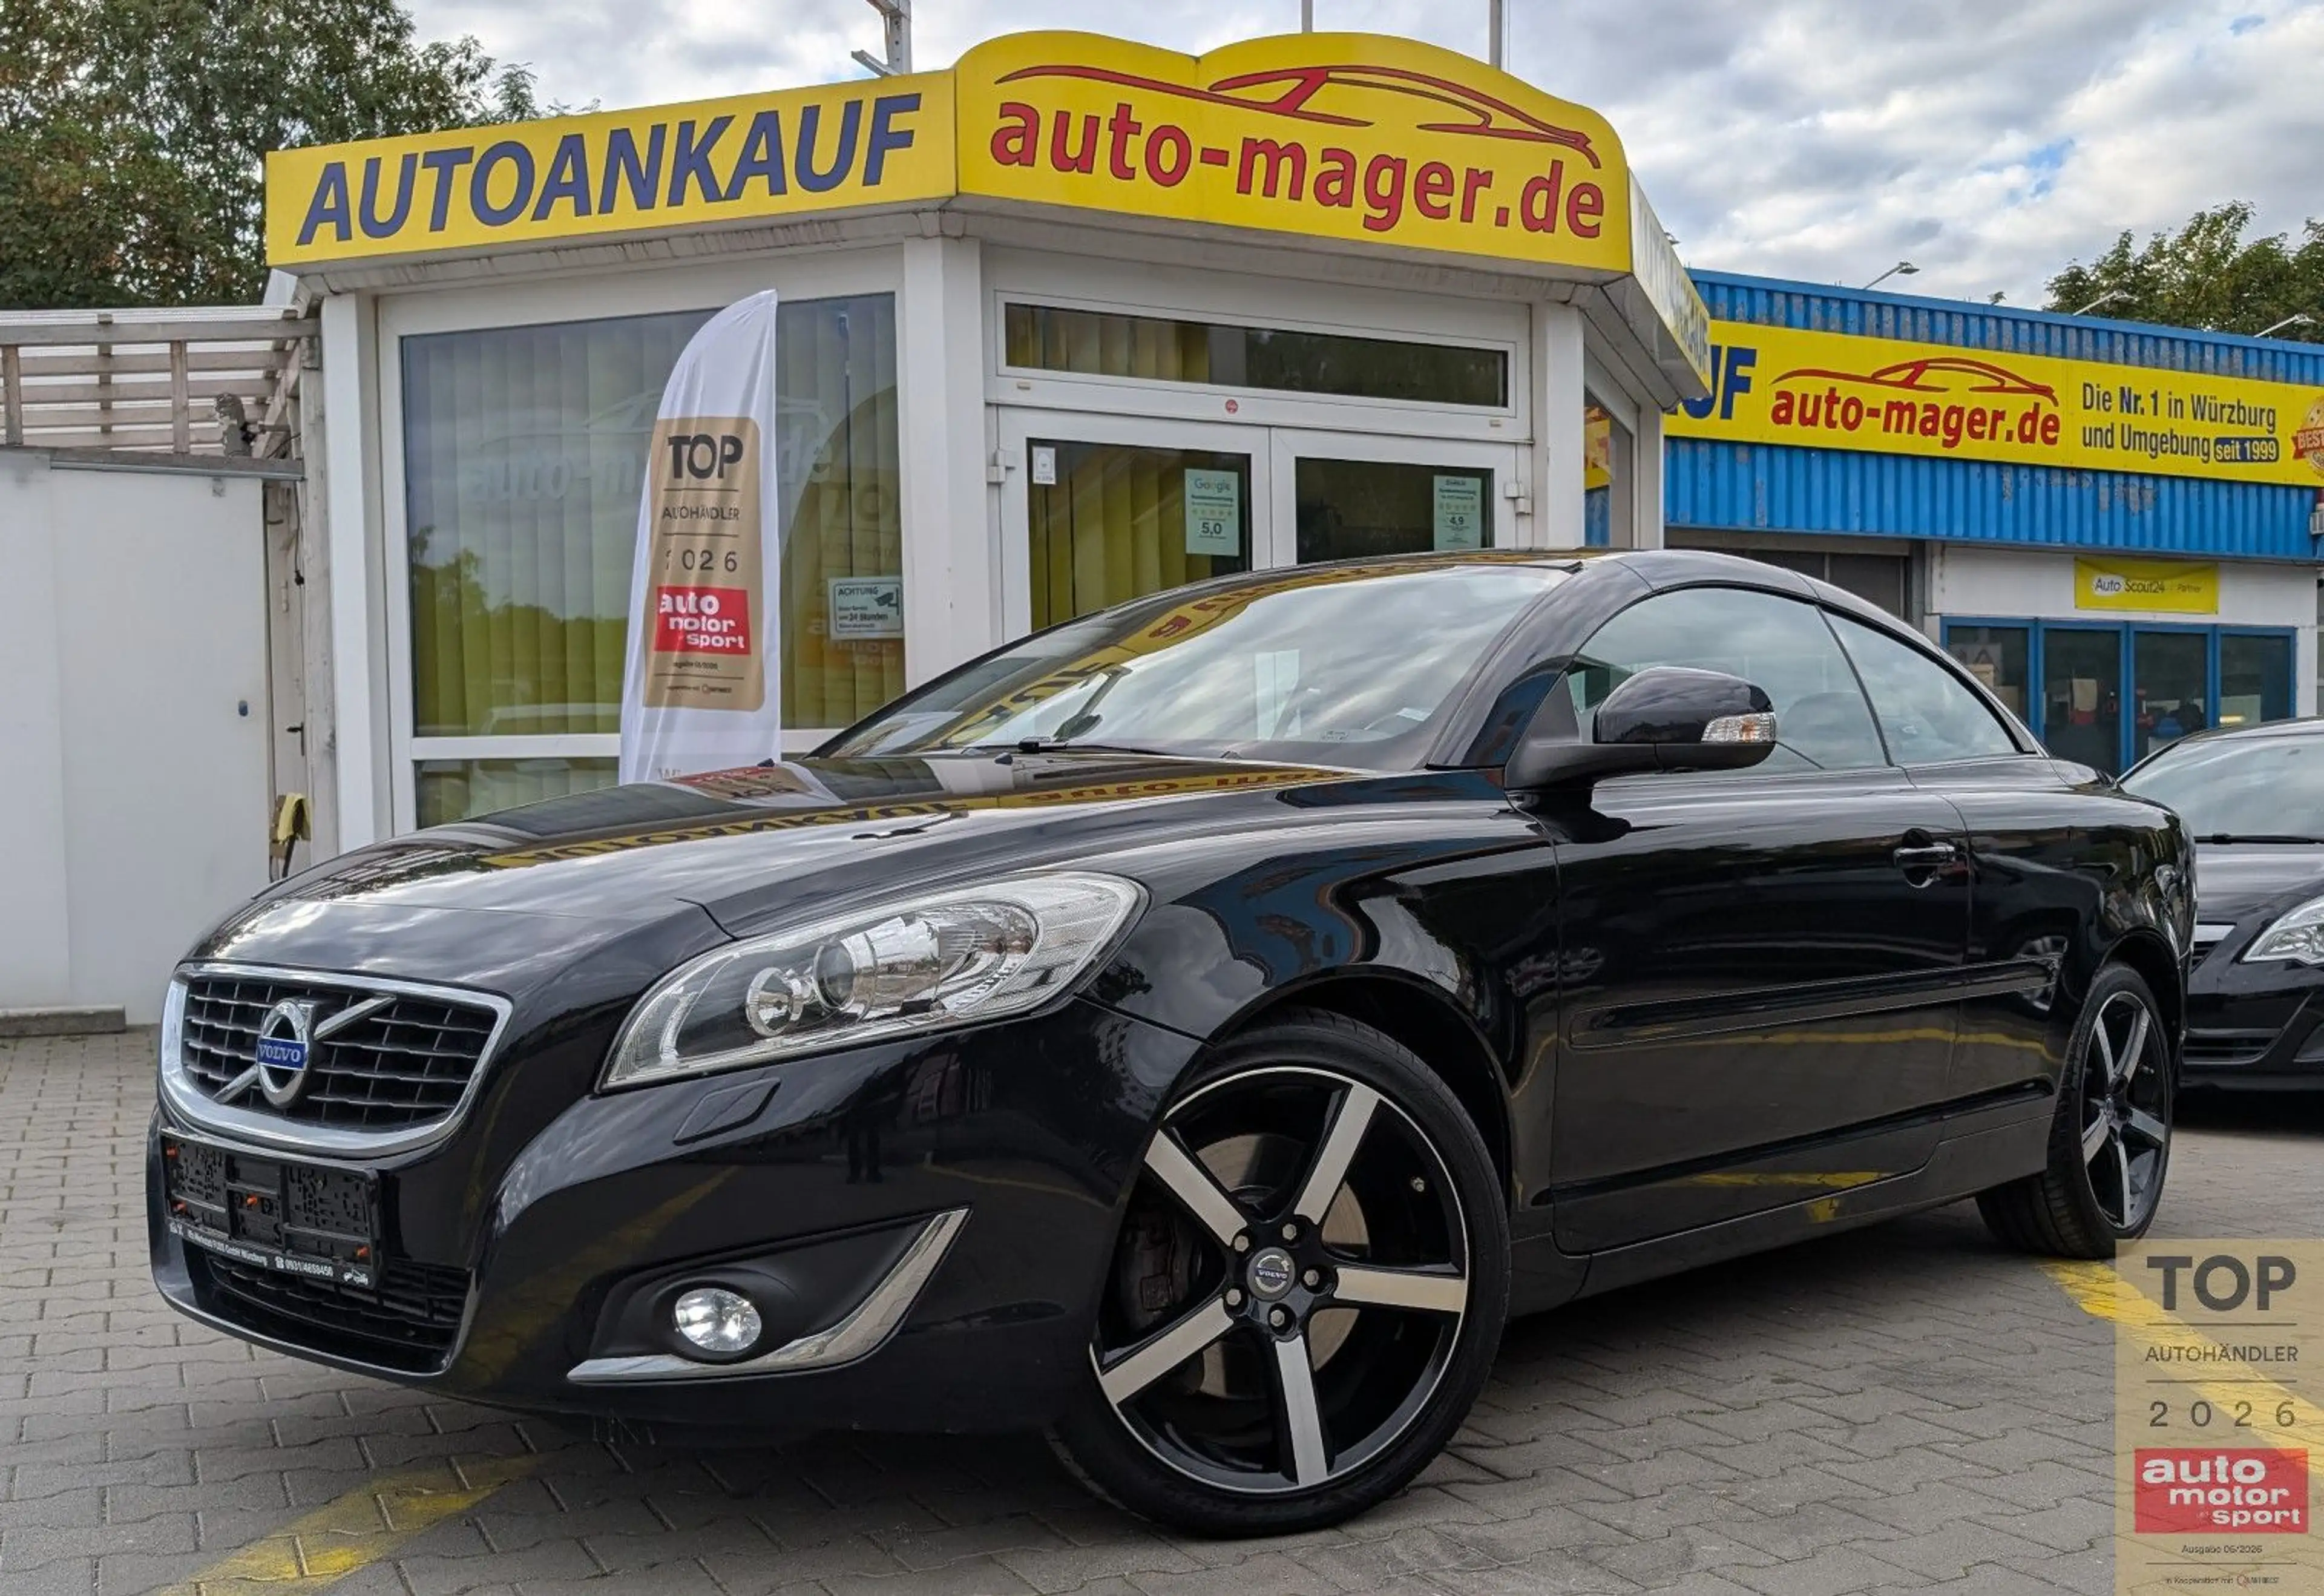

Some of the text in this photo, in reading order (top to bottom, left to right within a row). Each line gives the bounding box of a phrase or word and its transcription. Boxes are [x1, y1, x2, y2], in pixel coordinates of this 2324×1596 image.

[295, 92, 922, 246] AUTOANKAUF
[990, 100, 1605, 238] auto-mager.de
[1664, 344, 1757, 419] UF
[1771, 386, 2060, 449] auto-mager.de
[2082, 382, 2112, 412] Die
[2168, 391, 2184, 419] in
[2190, 393, 2276, 434] Würzburg
[668, 434, 743, 479] TOP
[2083, 422, 2277, 464] und Umgebung seit 1999
[1201, 522, 1222, 536] 5,0
[838, 586, 879, 597] ACHTUNG
[2094, 576, 2121, 592] Auto
[659, 591, 720, 615] auto
[686, 633, 744, 648] sport
[258, 1043, 301, 1063] VOLVO
[1258, 1269, 1288, 1279] VOLVO
